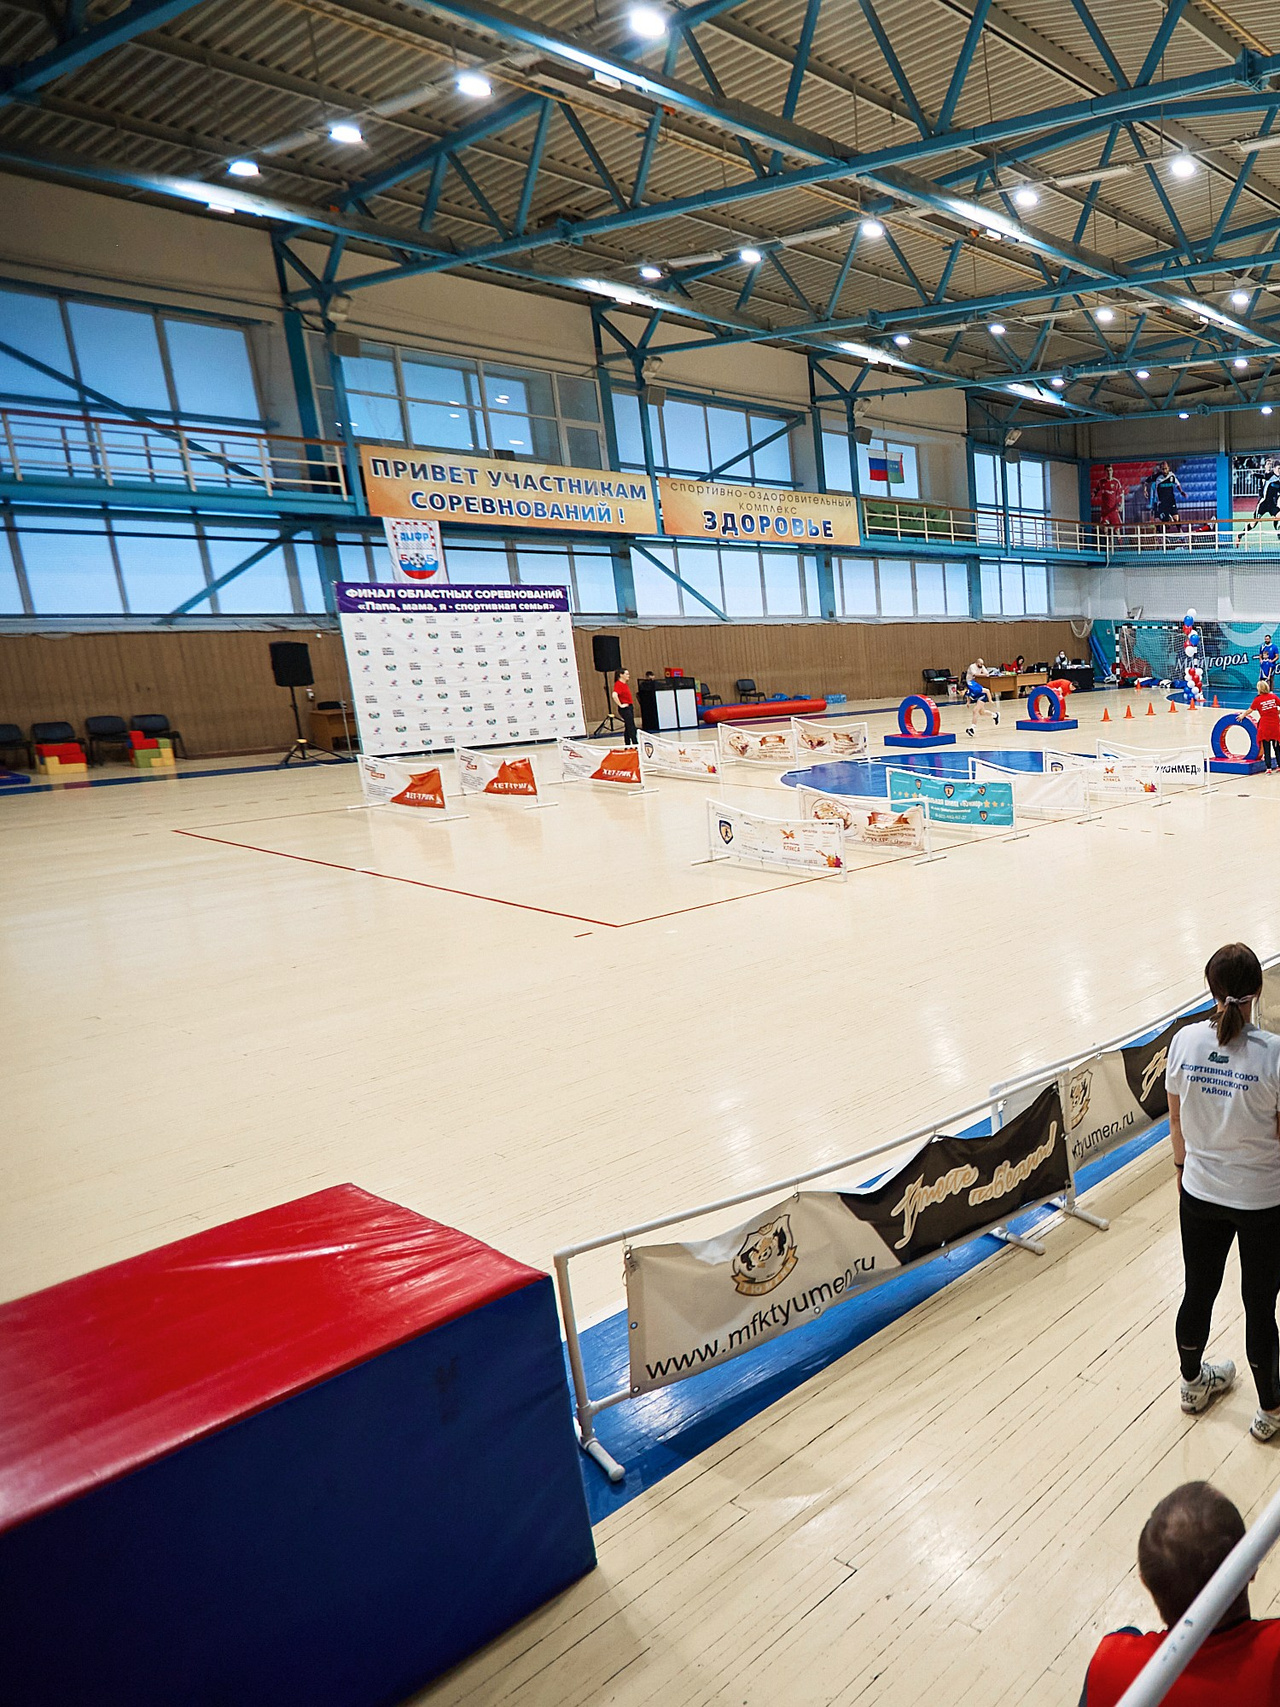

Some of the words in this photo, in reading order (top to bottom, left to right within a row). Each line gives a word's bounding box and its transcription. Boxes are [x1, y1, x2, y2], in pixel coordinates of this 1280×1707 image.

[371, 458, 479, 485] ПРИВЕТ
[487, 470, 647, 501] УЧАСТНИКАМ
[410, 491, 613, 524] СОРЕВНОВАНИЙ
[619, 507, 626, 525] !
[703, 510, 835, 540] ЗДОРОВЬЕ
[345, 588, 396, 599] ФИНАЛ
[400, 588, 474, 600] ОБЛАСТНЫХ
[475, 588, 564, 600] СОРЕВНОВАНИЙ
[358, 601, 401, 612] «Папа,
[402, 603, 438, 613] мама,
[439, 603, 447, 611] я
[454, 603, 517, 613] спортивная
[518, 602, 556, 611] семья»
[1209, 653, 1249, 671] город
[1181, 1063, 1233, 1078] СПОРТИВНЫЙ
[1234, 1072, 1260, 1082] СОЮЗ
[1187, 1074, 1249, 1092] СОРОКИНСКОГО
[1201, 1086, 1233, 1098] РАЙОНА
